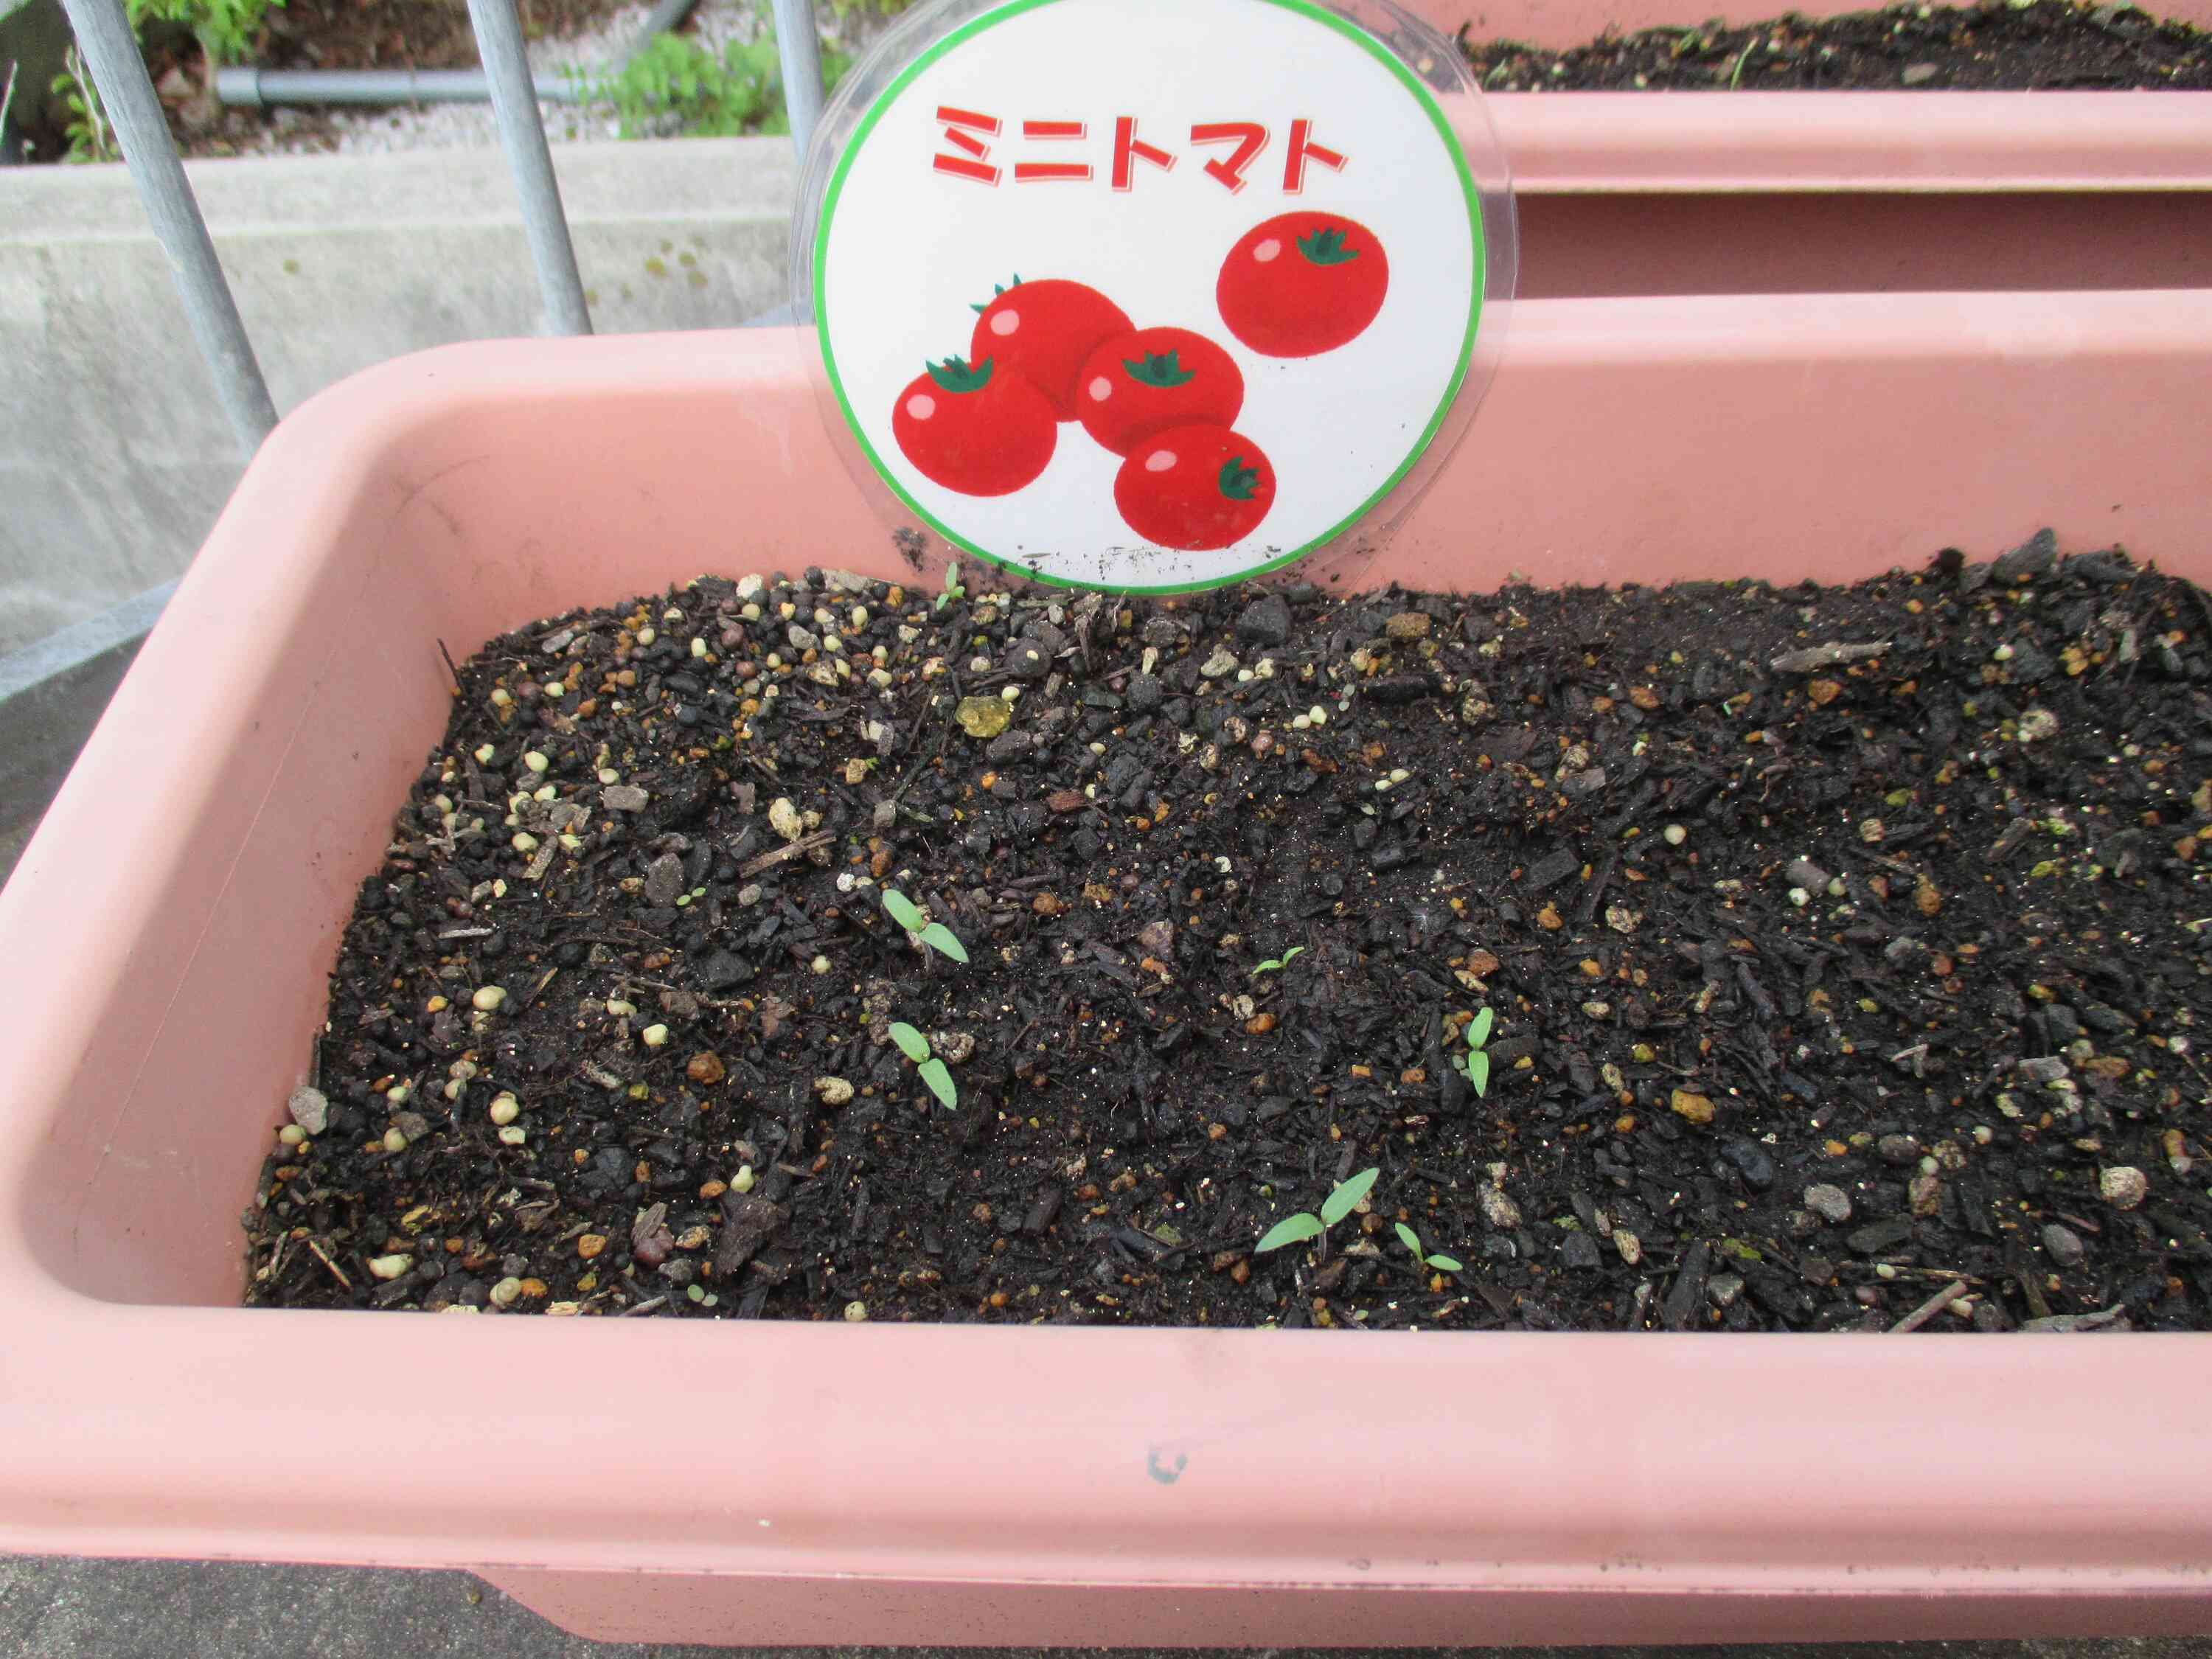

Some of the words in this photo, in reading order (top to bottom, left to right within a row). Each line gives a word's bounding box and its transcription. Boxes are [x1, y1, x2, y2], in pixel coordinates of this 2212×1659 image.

[933, 105, 1349, 195] ミニトマト
